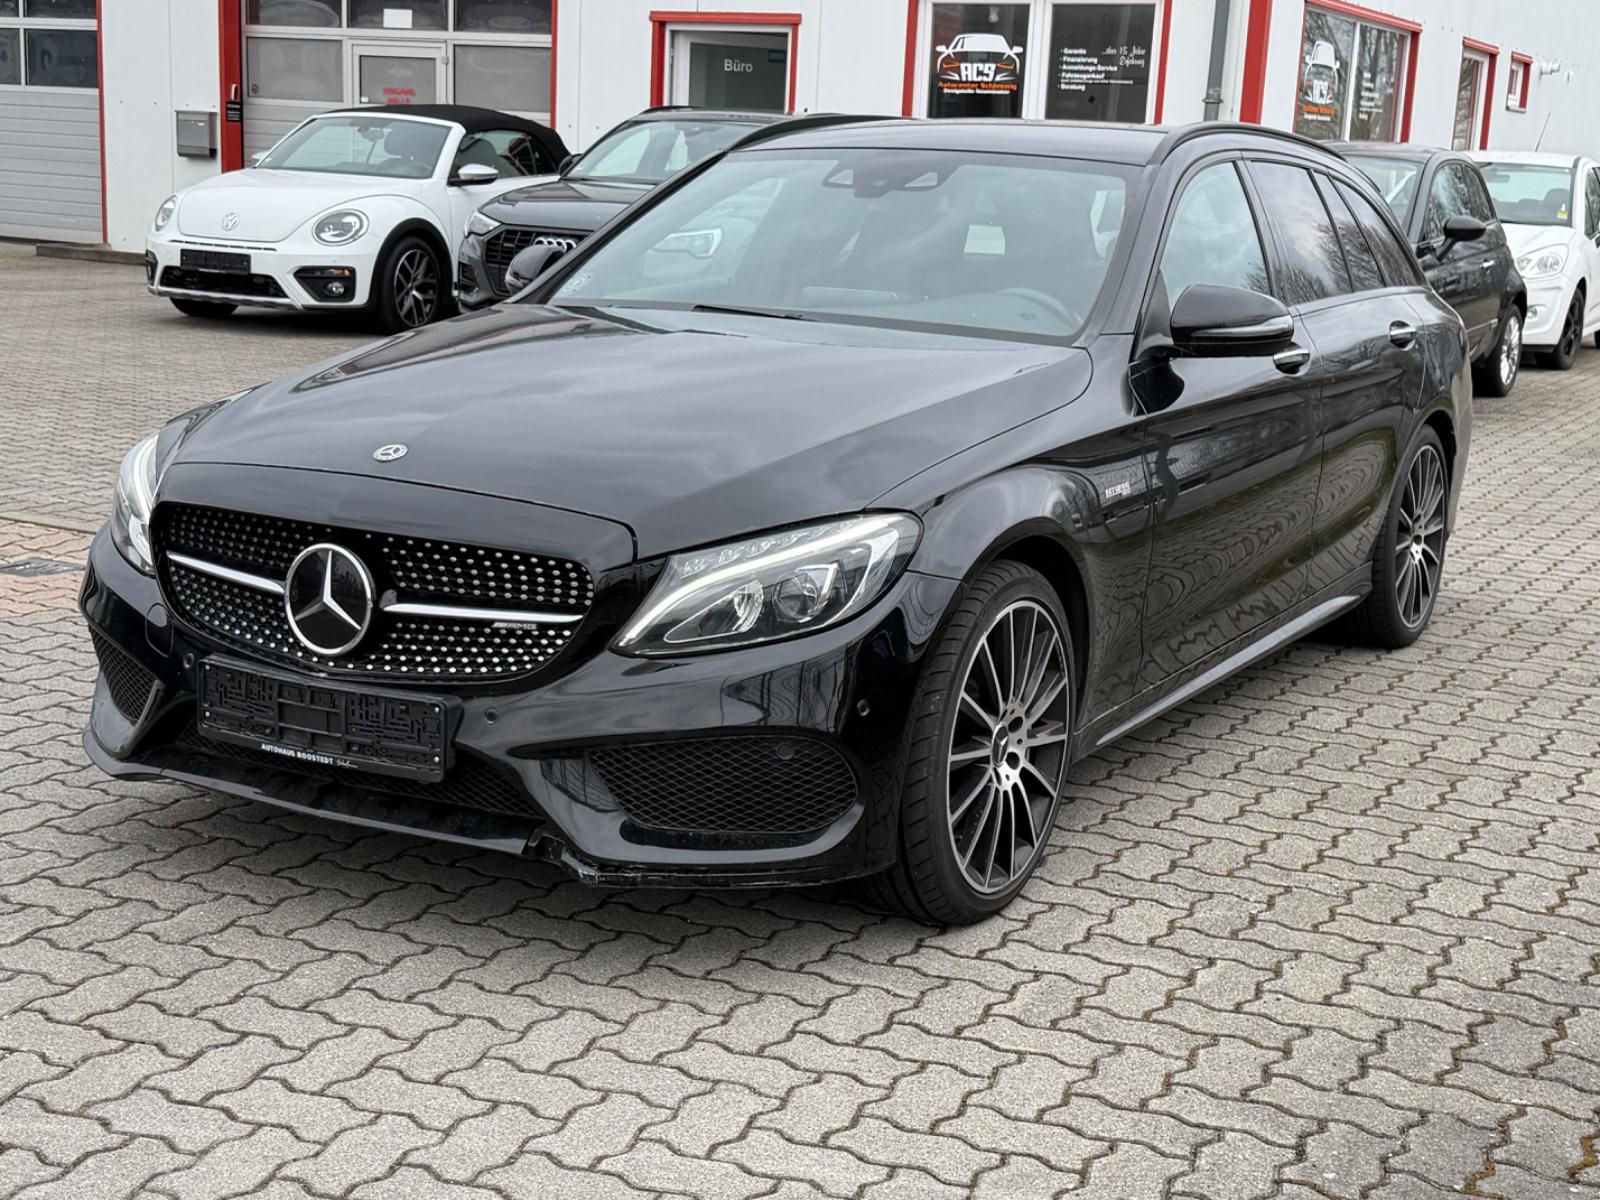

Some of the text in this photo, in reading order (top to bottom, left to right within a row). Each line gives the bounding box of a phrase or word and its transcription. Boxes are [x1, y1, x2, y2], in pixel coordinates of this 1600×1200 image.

[724, 58, 753, 72] Büro
[261, 743, 296, 757] AUTOHAUS
[296, 751, 334, 765] BOOSTEDT
